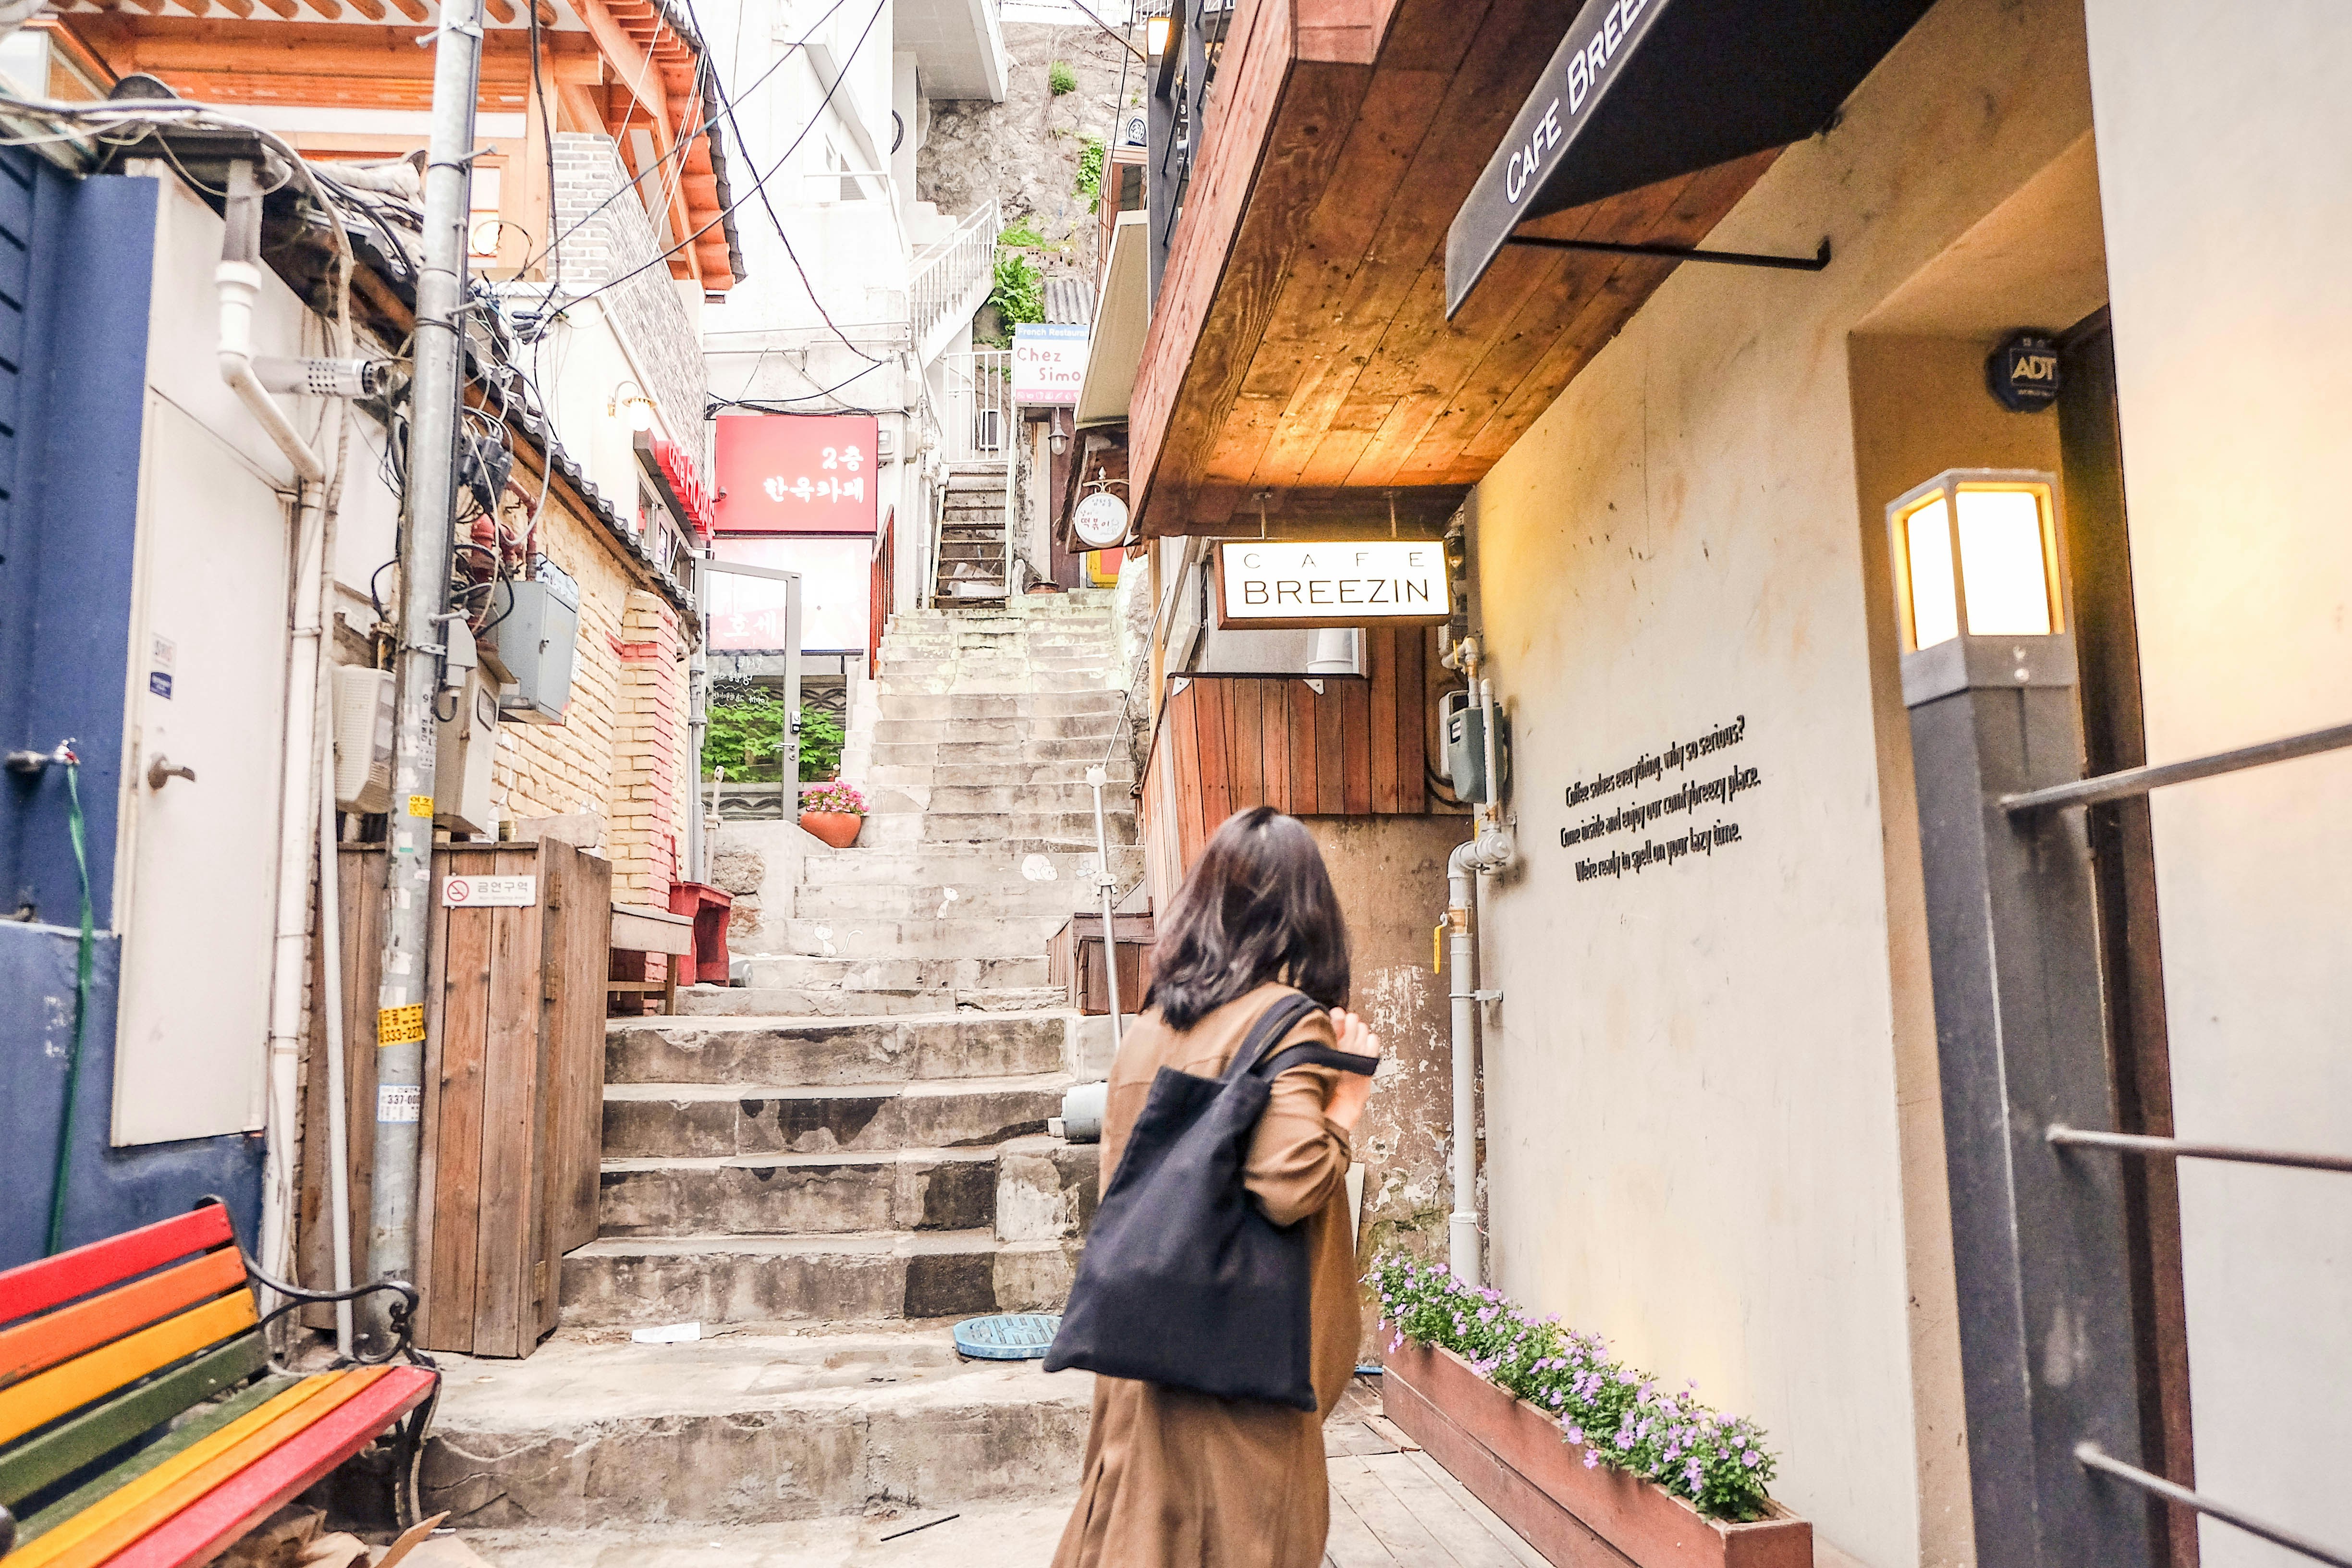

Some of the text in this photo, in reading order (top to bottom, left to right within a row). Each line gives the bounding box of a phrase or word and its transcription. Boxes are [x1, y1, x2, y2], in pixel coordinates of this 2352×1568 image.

[1506, 0, 1649, 204] CAFE BREE
[1018, 328, 1089, 337] French Restauran
[1017, 347, 1061, 362] Chez
[1039, 367, 1081, 381] Simo
[2011, 355, 2057, 380] ADT
[822, 445, 864, 472] 2층
[763, 476, 864, 503] 한옥카페
[1244, 552, 1424, 569] CAFE
[1244, 579, 1429, 604] BREEZIN
[1566, 714, 1745, 808] Coffee solves everything, why so serious?
[1561, 827, 1580, 848] Come
[1581, 814, 1605, 842] inside
[1606, 807, 1622, 834] and
[1622, 801, 1645, 833] enjoy
[1646, 799, 1662, 821] our
[1728, 764, 1762, 803] place.
[1575, 857, 1597, 883] We're
[1598, 850, 1620, 880] ready
[1631, 839, 1653, 875] spell
[1653, 844, 1666, 863] on
[1666, 836, 1689, 866] your
[1690, 826, 1712, 857] lazy
[1713, 819, 1742, 846] time.
[478, 882, 528, 893] 금연구역
